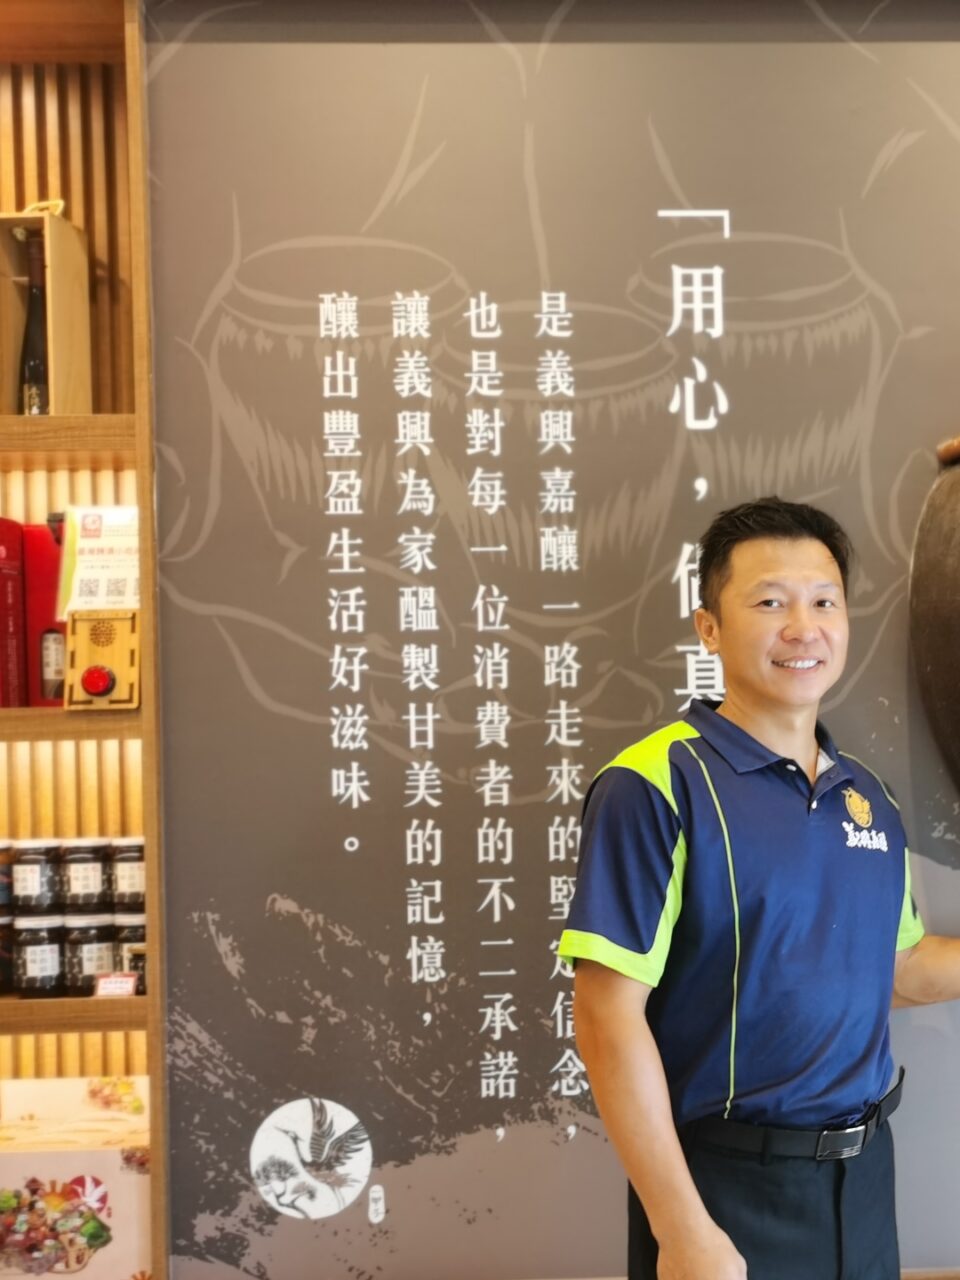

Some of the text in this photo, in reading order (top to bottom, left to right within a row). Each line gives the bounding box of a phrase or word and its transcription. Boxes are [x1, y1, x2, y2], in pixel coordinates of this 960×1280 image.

[318, 291, 369, 853] 釀出豐盈生活好滋味。
[462, 291, 519, 1143] 也是對每一位消費者的不二承諾，
